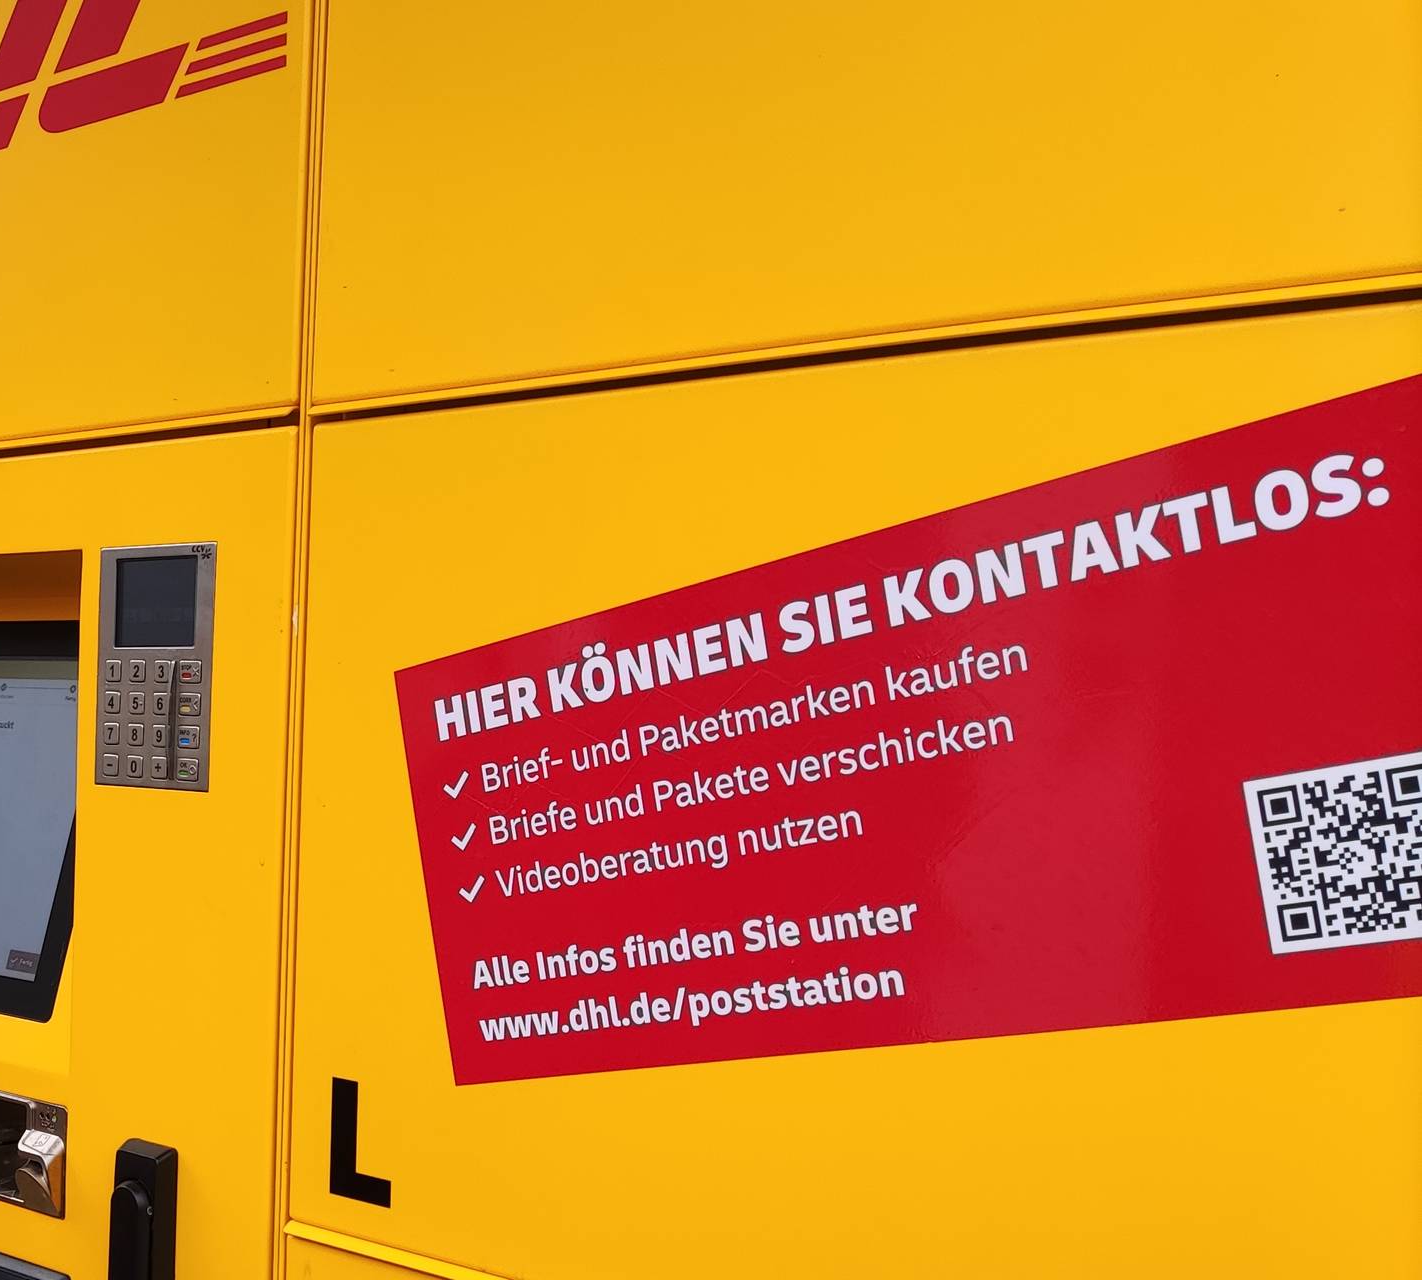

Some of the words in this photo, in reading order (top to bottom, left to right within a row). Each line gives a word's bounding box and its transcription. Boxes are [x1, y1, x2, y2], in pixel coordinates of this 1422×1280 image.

[434, 677, 542, 742] HIER
[546, 612, 768, 713] KÖNNEN
[778, 583, 873, 653] SIE
[883, 454, 1391, 628] KONTAKTLOS:
[107, 696, 115, 709] 4
[132, 697, 139, 710] 5
[157, 698, 164, 711] 6
[109, 665, 115, 678] 1
[133, 665, 140, 678] 2
[158, 666, 165, 679] 3
[107, 727, 114, 740] 7
[131, 728, 138, 741] 8
[156, 730, 163, 743] 9
[481, 747, 564, 793] Brief-
[571, 728, 631, 772] und
[638, 680, 876, 757] Paketmarken
[884, 645, 1028, 701] kaufen
[130, 760, 137, 774] 0
[488, 801, 577, 845] Briefe
[584, 783, 645, 826] und
[652, 765, 770, 812] Pakete
[776, 715, 1014, 786] verschicken
[494, 834, 729, 897] Videoberatung
[737, 810, 863, 856] nutzen
[473, 955, 531, 990] Alle
[535, 944, 617, 981] Infos
[622, 928, 735, 969] finden
[742, 914, 801, 952] Sie
[808, 903, 918, 943] unter
[479, 966, 905, 1042] www.dhl.de/poststation
[329, 1076, 392, 1208] L
